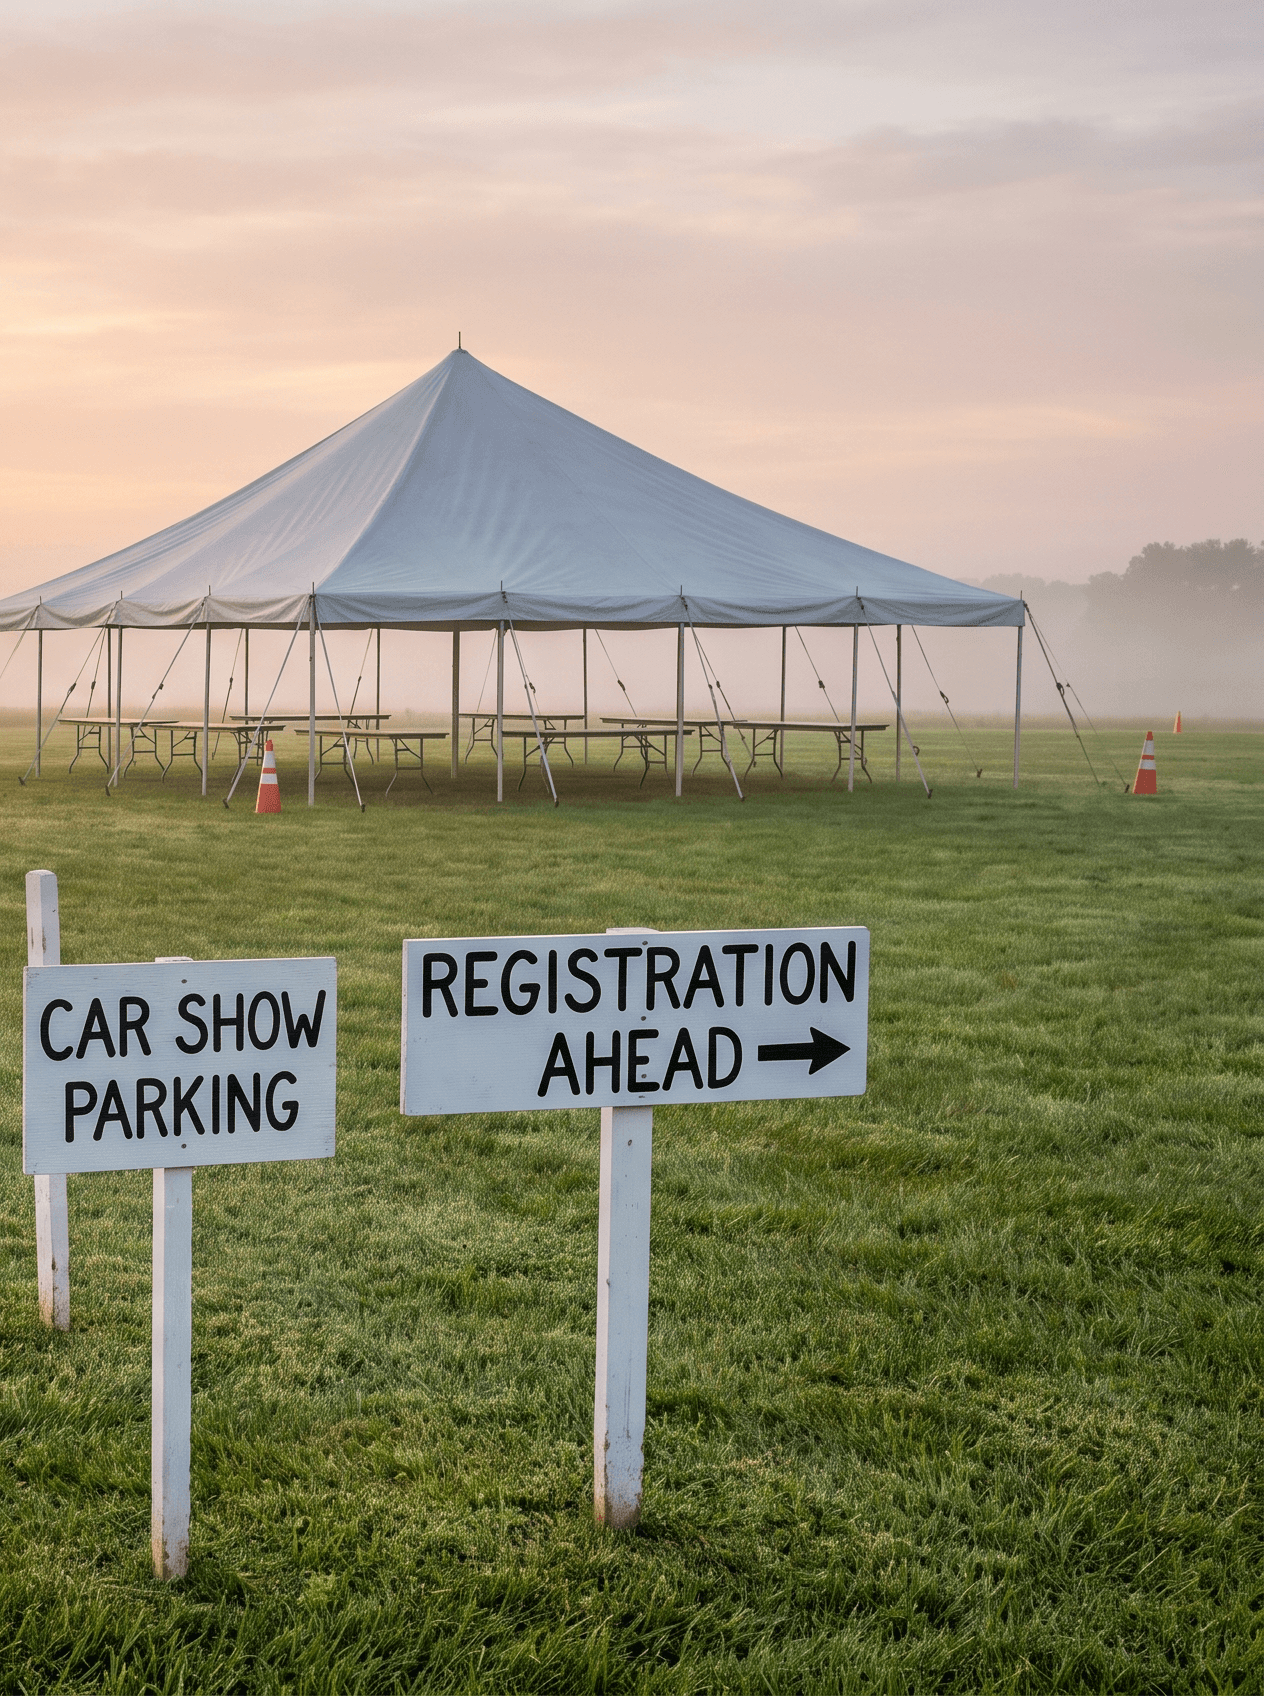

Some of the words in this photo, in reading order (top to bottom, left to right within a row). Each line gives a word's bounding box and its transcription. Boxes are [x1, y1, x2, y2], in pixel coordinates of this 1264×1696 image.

[422, 940, 857, 1019] REGISTRATION
[39, 996, 152, 1062] CAR
[175, 989, 327, 1055] SHOW
[537, 1026, 743, 1098] AHEAD
[64, 1070, 300, 1144] PARKING
